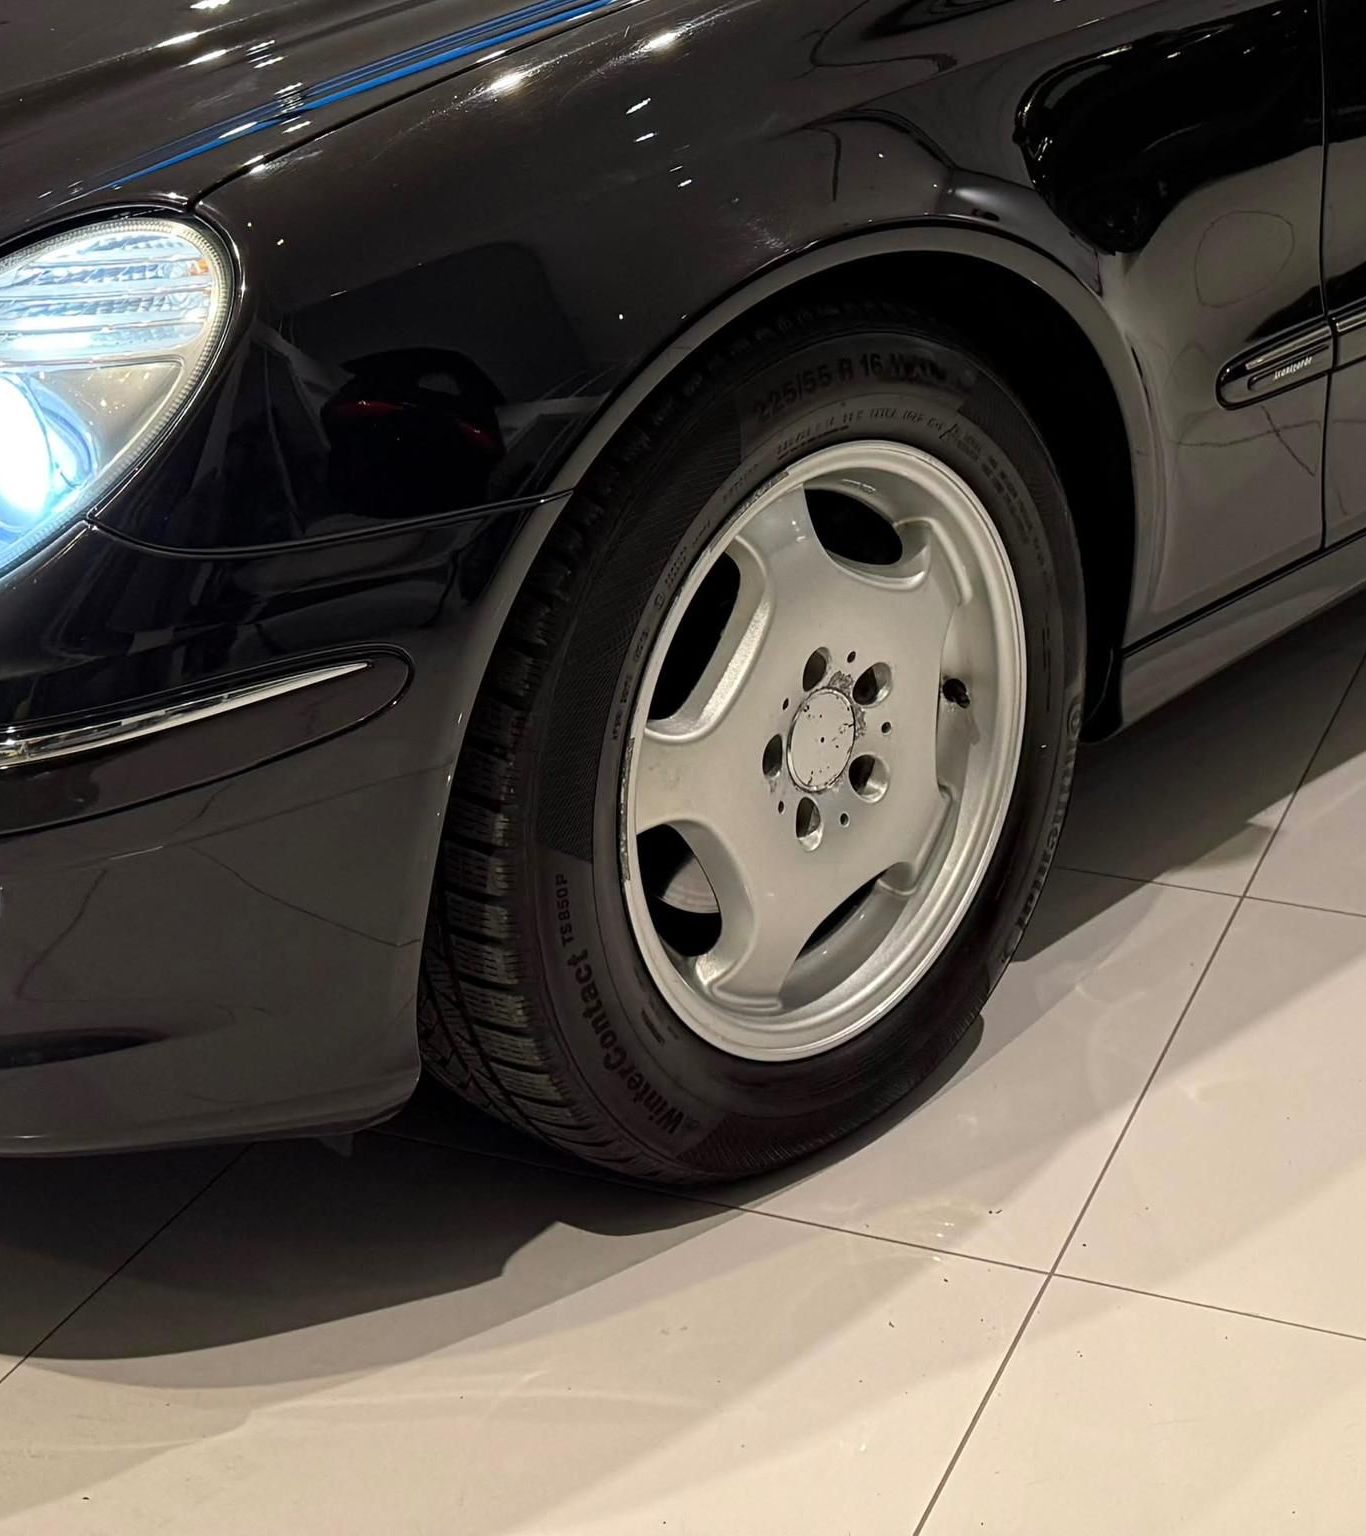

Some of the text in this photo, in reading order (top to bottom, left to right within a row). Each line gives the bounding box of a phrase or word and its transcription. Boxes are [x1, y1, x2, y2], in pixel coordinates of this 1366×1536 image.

[752, 365, 833, 419] 225/55
[839, 359, 854, 382] R
[860, 354, 885, 378] 16
[567, 949, 684, 1135] WinterContact
